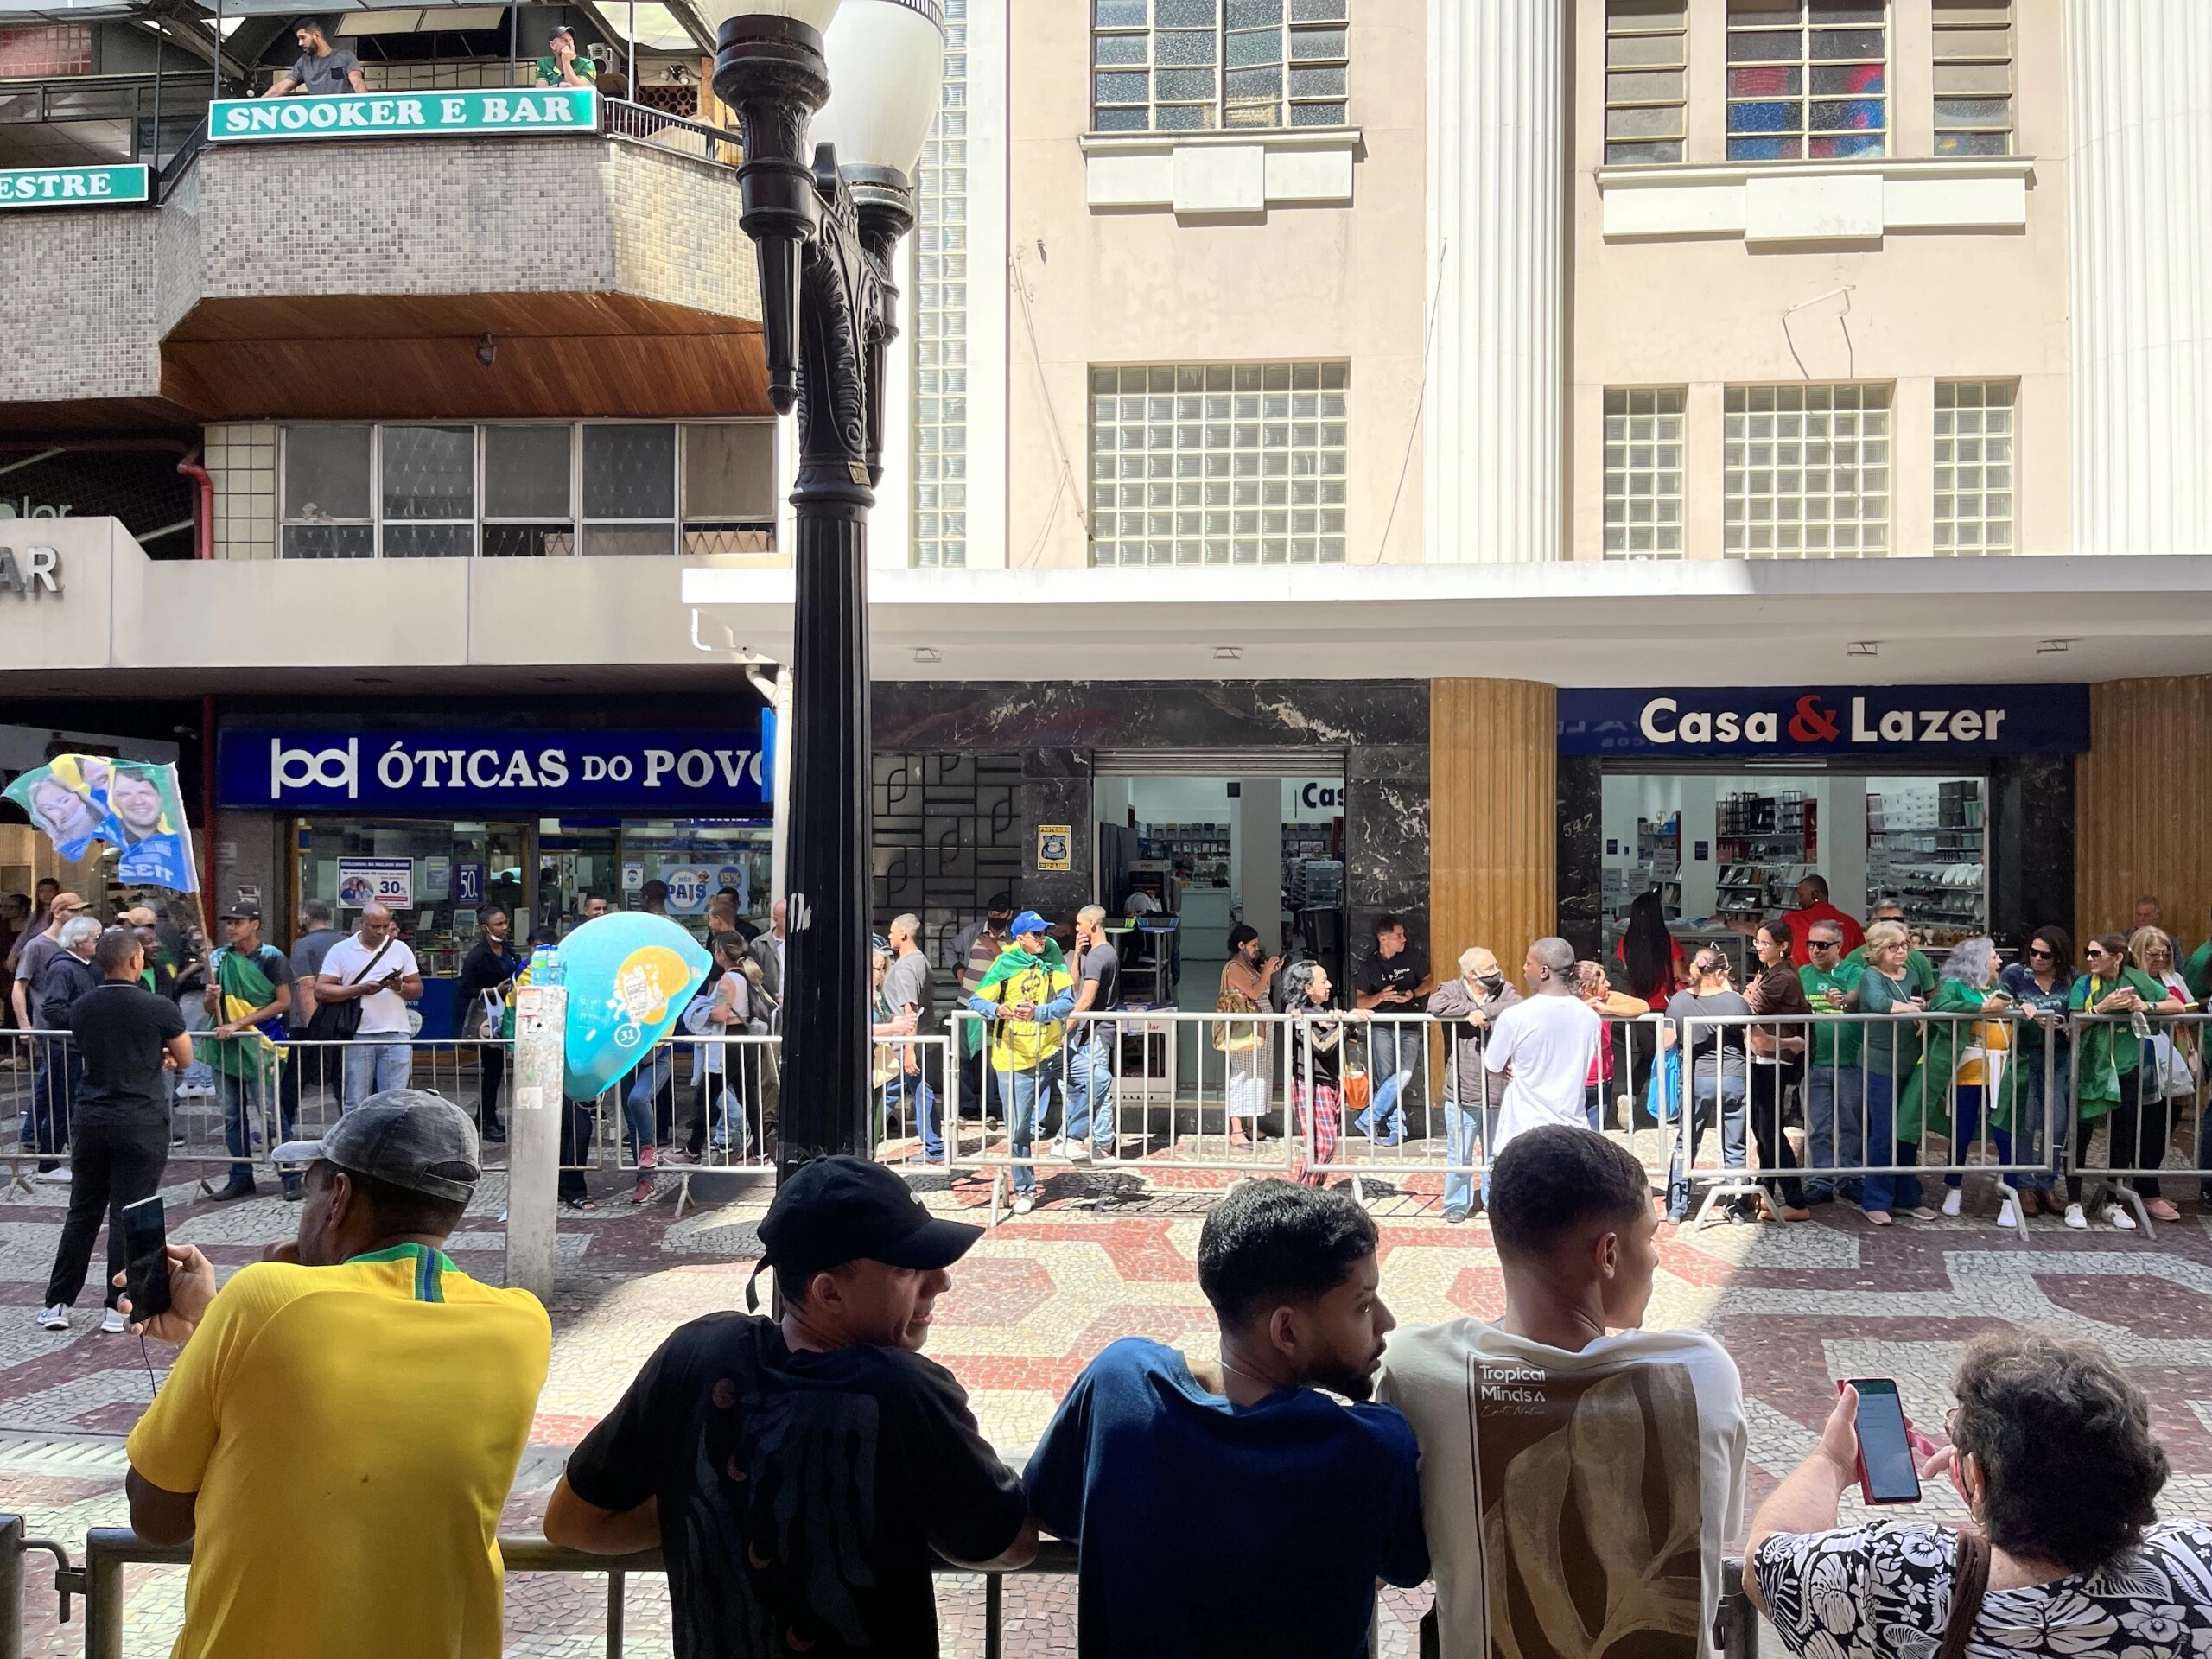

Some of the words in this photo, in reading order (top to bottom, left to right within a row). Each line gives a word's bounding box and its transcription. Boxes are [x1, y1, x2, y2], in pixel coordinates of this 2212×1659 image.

[226, 99, 425, 132] SNOOKER
[440, 98, 467, 124] E
[482, 96, 574, 124] BAR
[0, 173, 112, 200] ESTRE
[1639, 696, 1777, 744] Casa
[1788, 694, 1840, 743] &
[1852, 696, 2005, 743] Lazer
[377, 741, 569, 789] ÓTICAS
[582, 754, 632, 781] DO
[1563, 812, 1592, 837] 547
[620, 1028, 636, 1042] 31
[1478, 1363, 1546, 1383] Tropical
[1480, 1384, 1533, 1402] Minds
